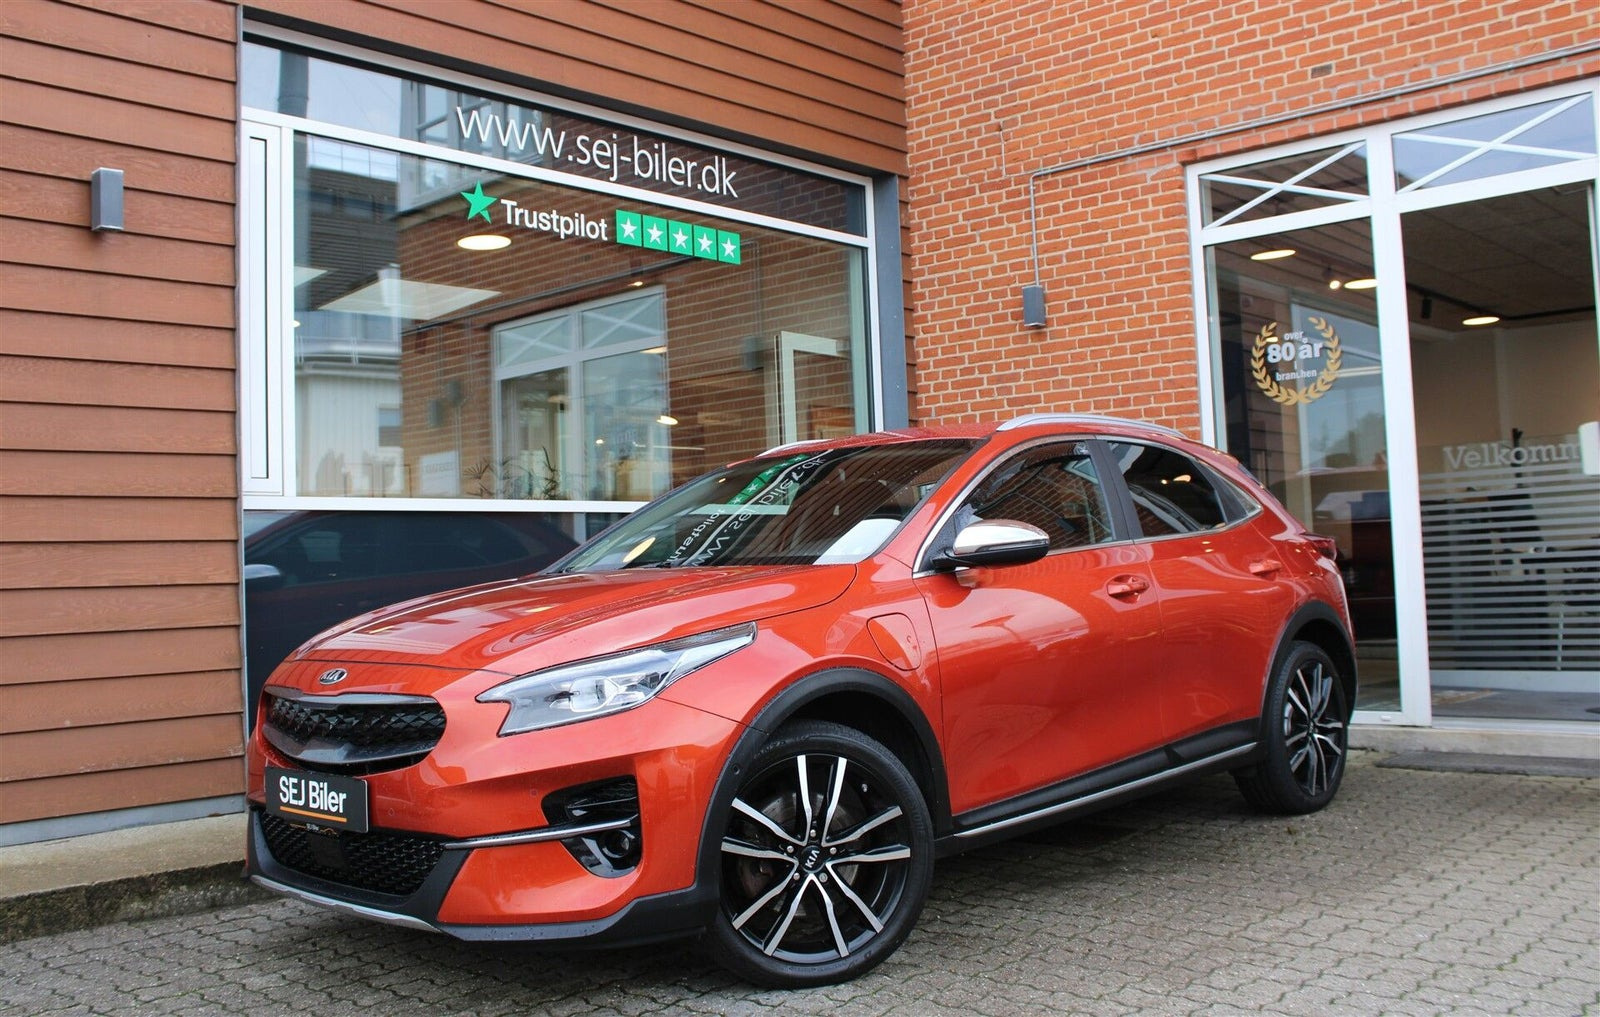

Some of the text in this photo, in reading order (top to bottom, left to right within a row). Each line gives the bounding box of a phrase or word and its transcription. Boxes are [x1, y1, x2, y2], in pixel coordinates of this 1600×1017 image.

[456, 106, 738, 198] www.sej-biler.dk
[501, 199, 608, 241] Trustpilot
[1267, 337, 1323, 364] 80 år
[1283, 331, 1304, 341] over
[279, 775, 347, 813] SEJ Biler
[805, 849, 820, 868] KIA
